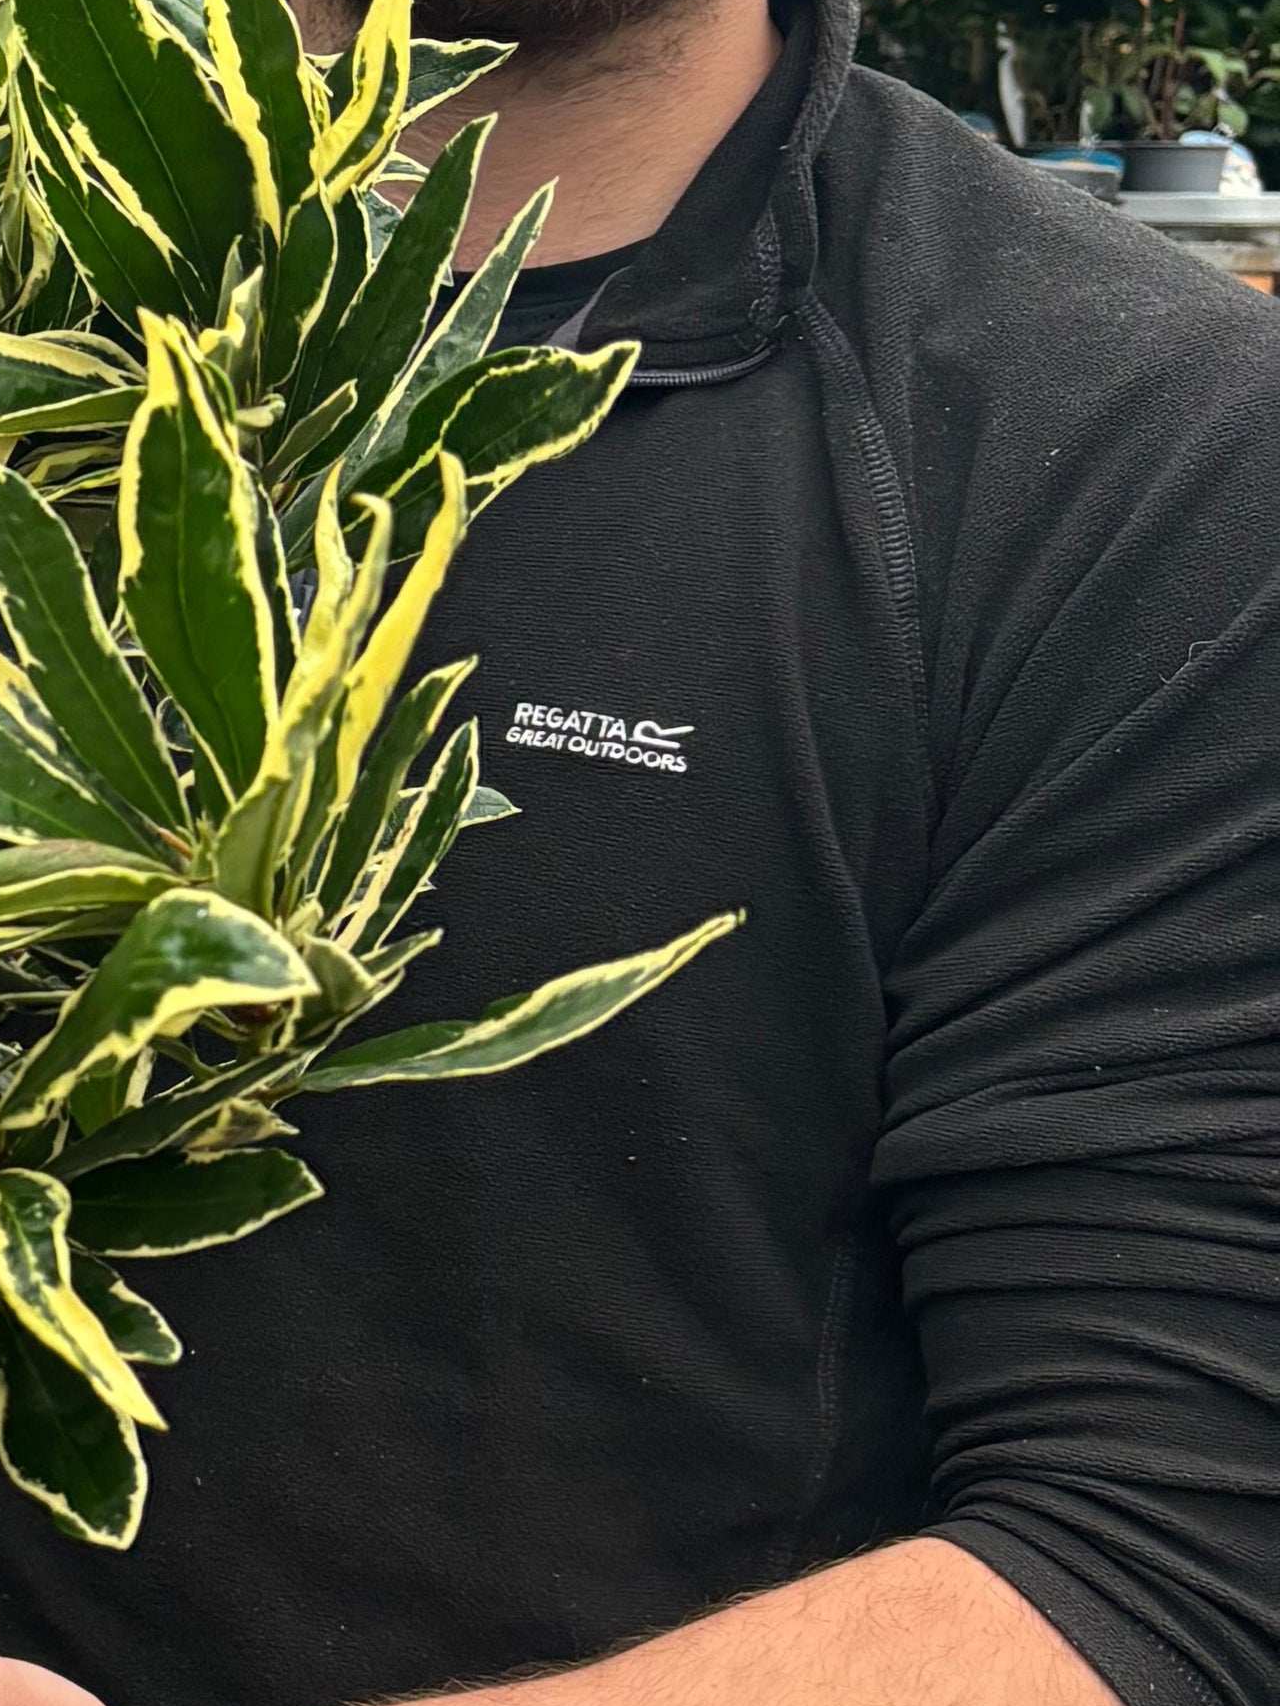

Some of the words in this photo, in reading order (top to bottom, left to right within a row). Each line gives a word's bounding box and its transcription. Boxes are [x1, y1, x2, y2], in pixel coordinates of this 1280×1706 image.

[514, 702, 627, 741] REGATTA
[505, 726, 567, 751] GREAT
[567, 736, 688, 773] OUTDOORS
